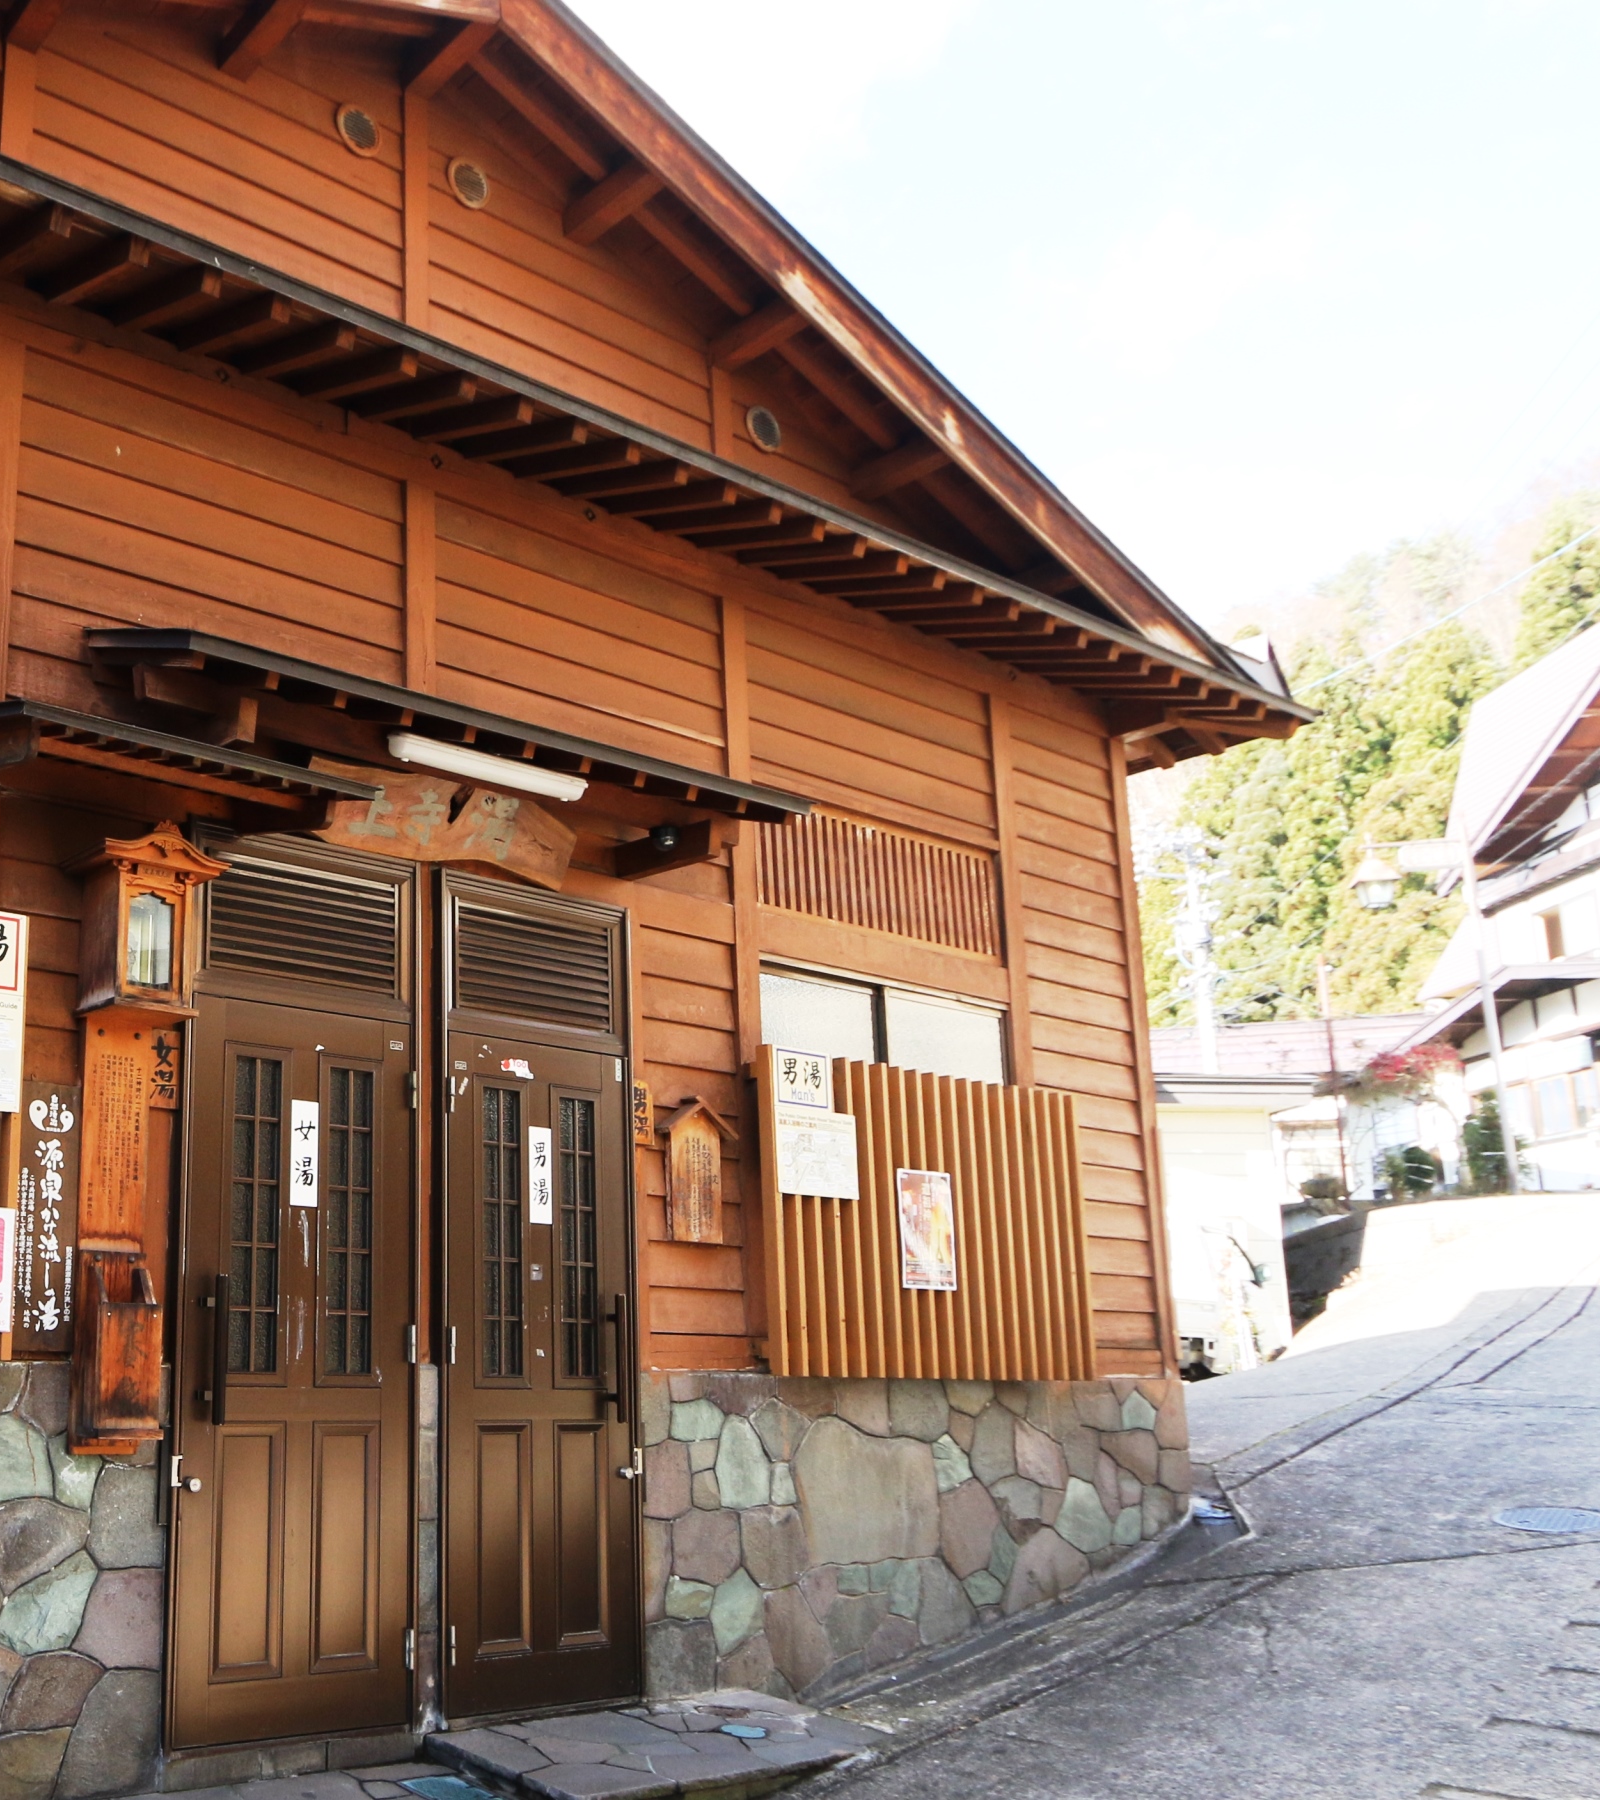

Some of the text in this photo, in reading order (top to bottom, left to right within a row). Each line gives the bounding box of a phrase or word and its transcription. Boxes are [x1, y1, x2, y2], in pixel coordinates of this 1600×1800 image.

[0, 1001, 18, 1010] Guide
[150, 1036, 179, 1100] 女湯
[783, 1057, 822, 1089] 男湯
[791, 1087, 816, 1103] Man's
[634, 1086, 650, 1138] 男湯
[294, 1120, 316, 1187] 女湯
[532, 1142, 549, 1206] 男湯
[32, 1138, 64, 1332] 源泉かけ流しの湯
